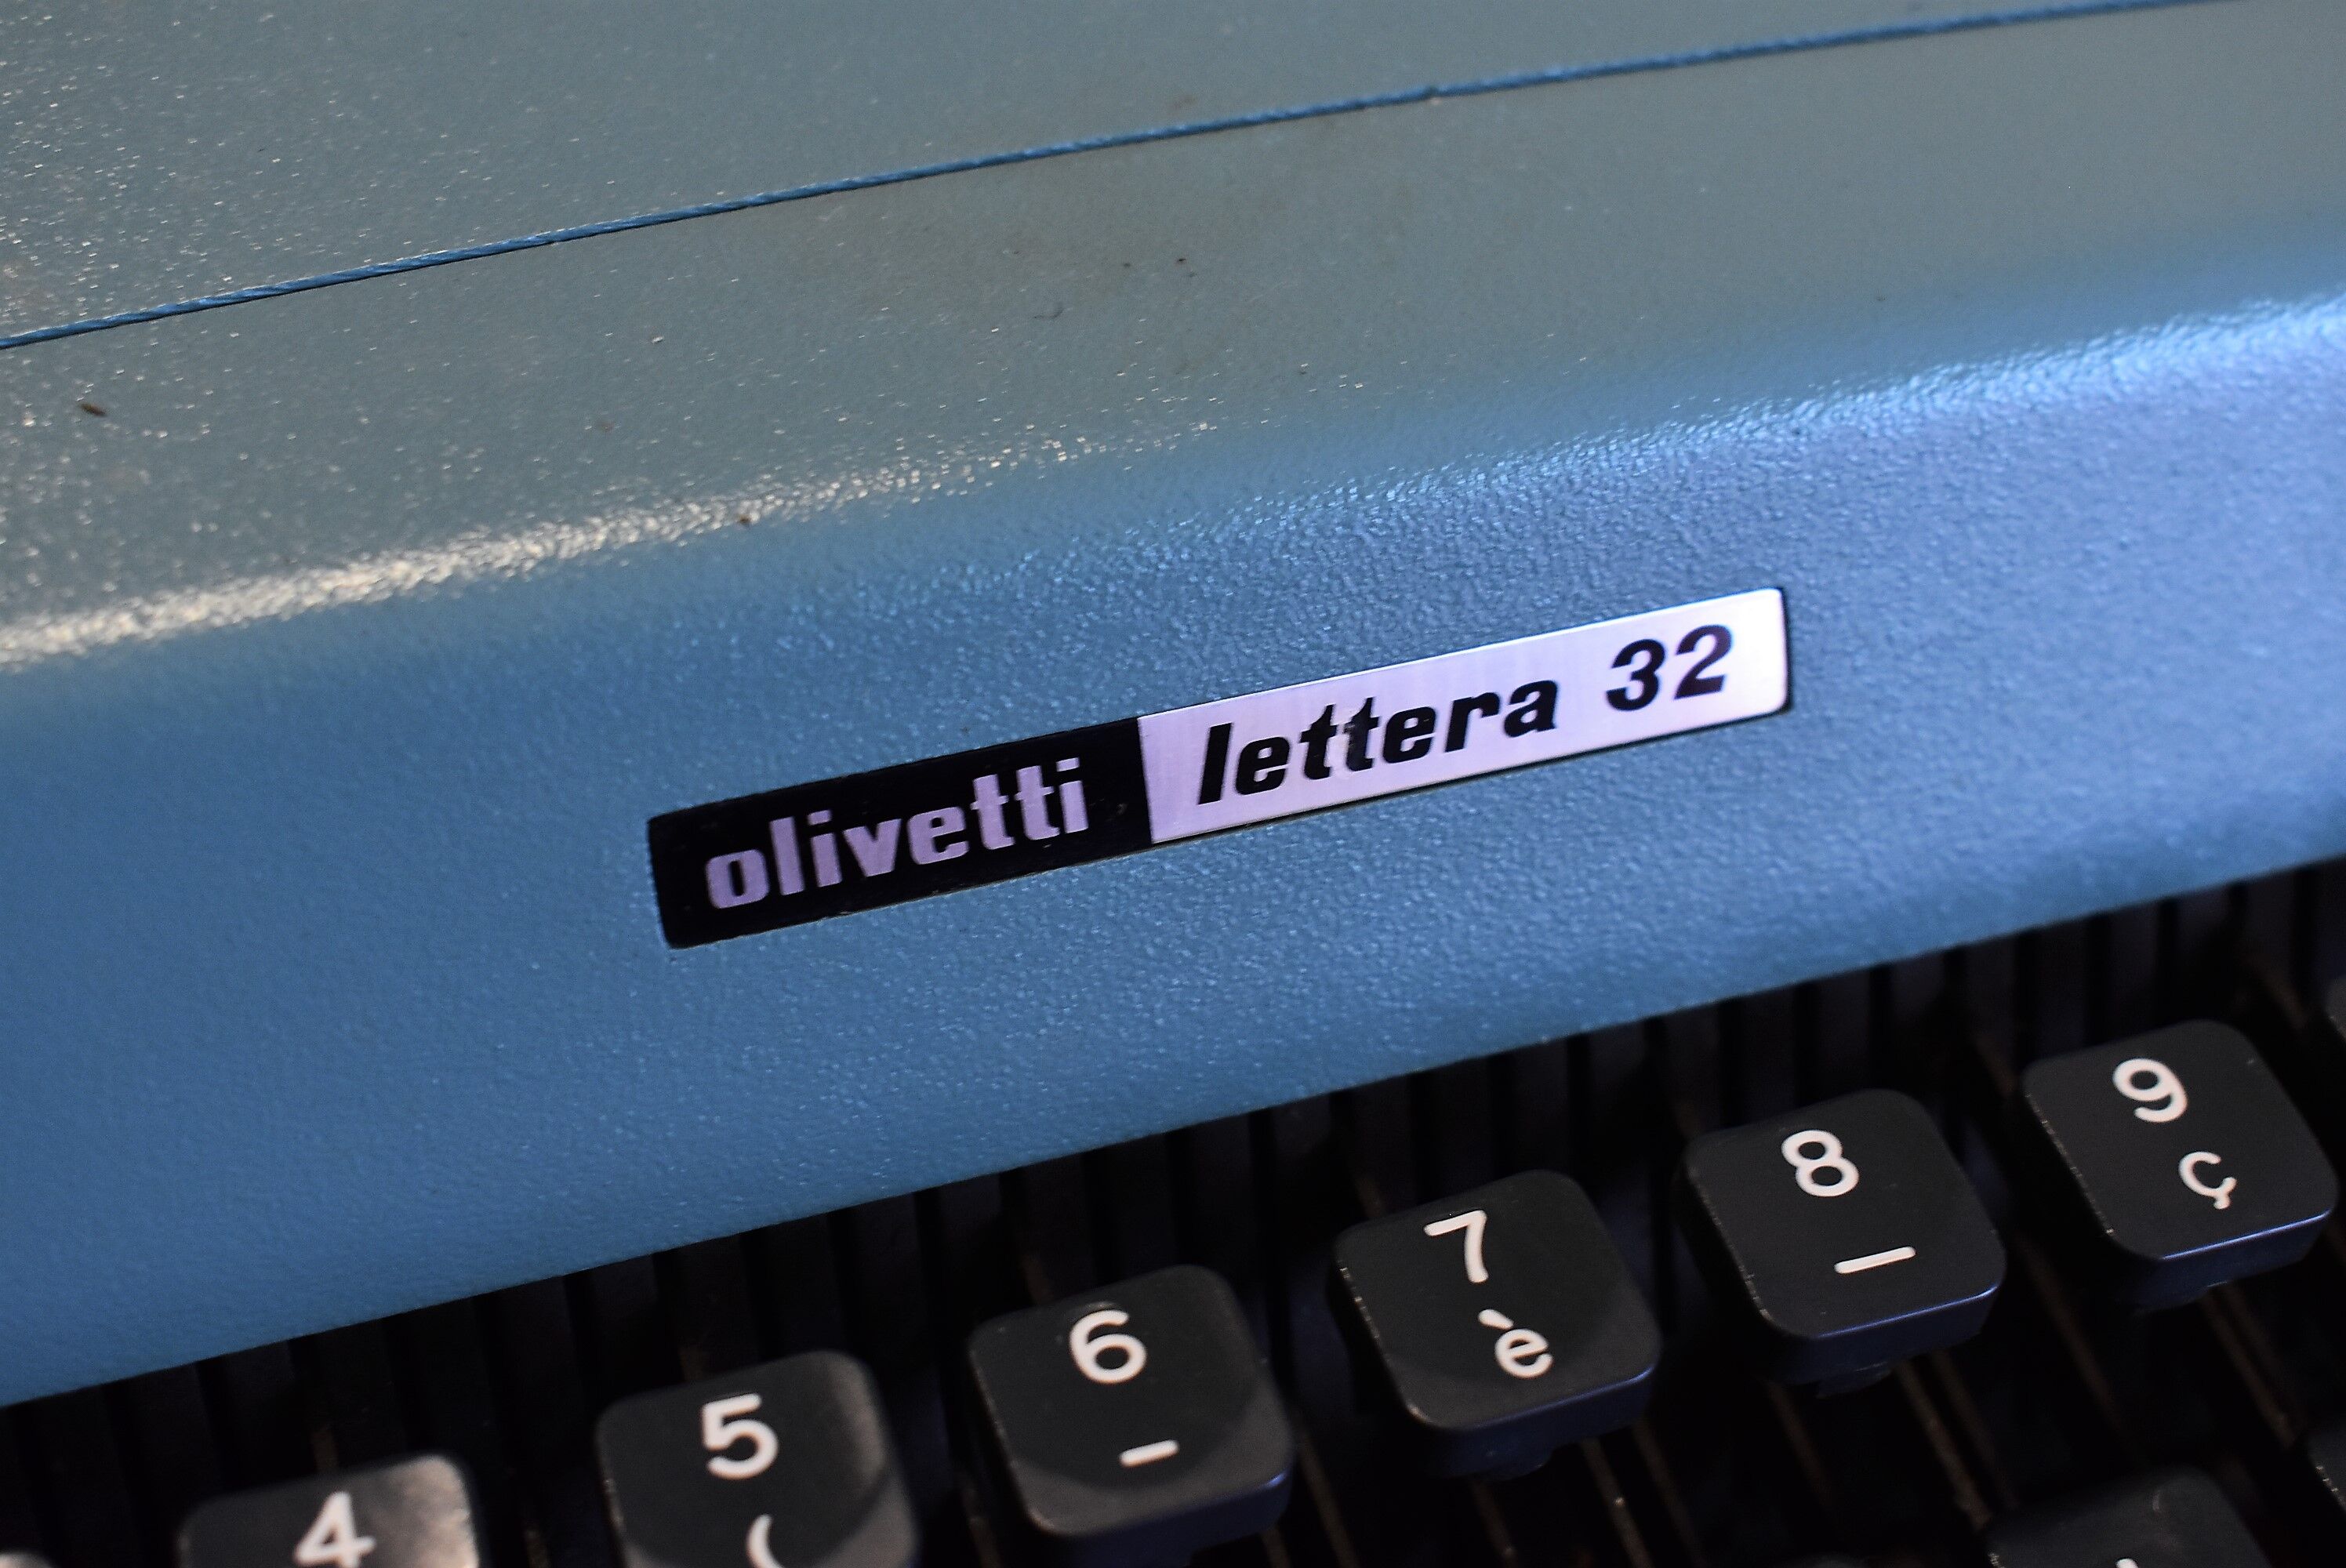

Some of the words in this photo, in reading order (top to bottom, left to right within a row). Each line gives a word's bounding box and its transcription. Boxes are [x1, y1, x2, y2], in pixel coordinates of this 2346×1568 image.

[706, 756, 1090, 909] olivetti
[1197, 679, 1560, 806] lettera
[1606, 625, 1732, 713] 32
[2113, 1058, 2188, 1123] 9
[1781, 1129, 1859, 1198] 8
[2179, 1150, 2237, 1210] ç
[1423, 1209, 1489, 1283] 7
[1070, 1309, 1146, 1383] 6
[1478, 1308, 1552, 1378] è
[703, 1393, 779, 1479] 5
[294, 1490, 376, 1568] 4
